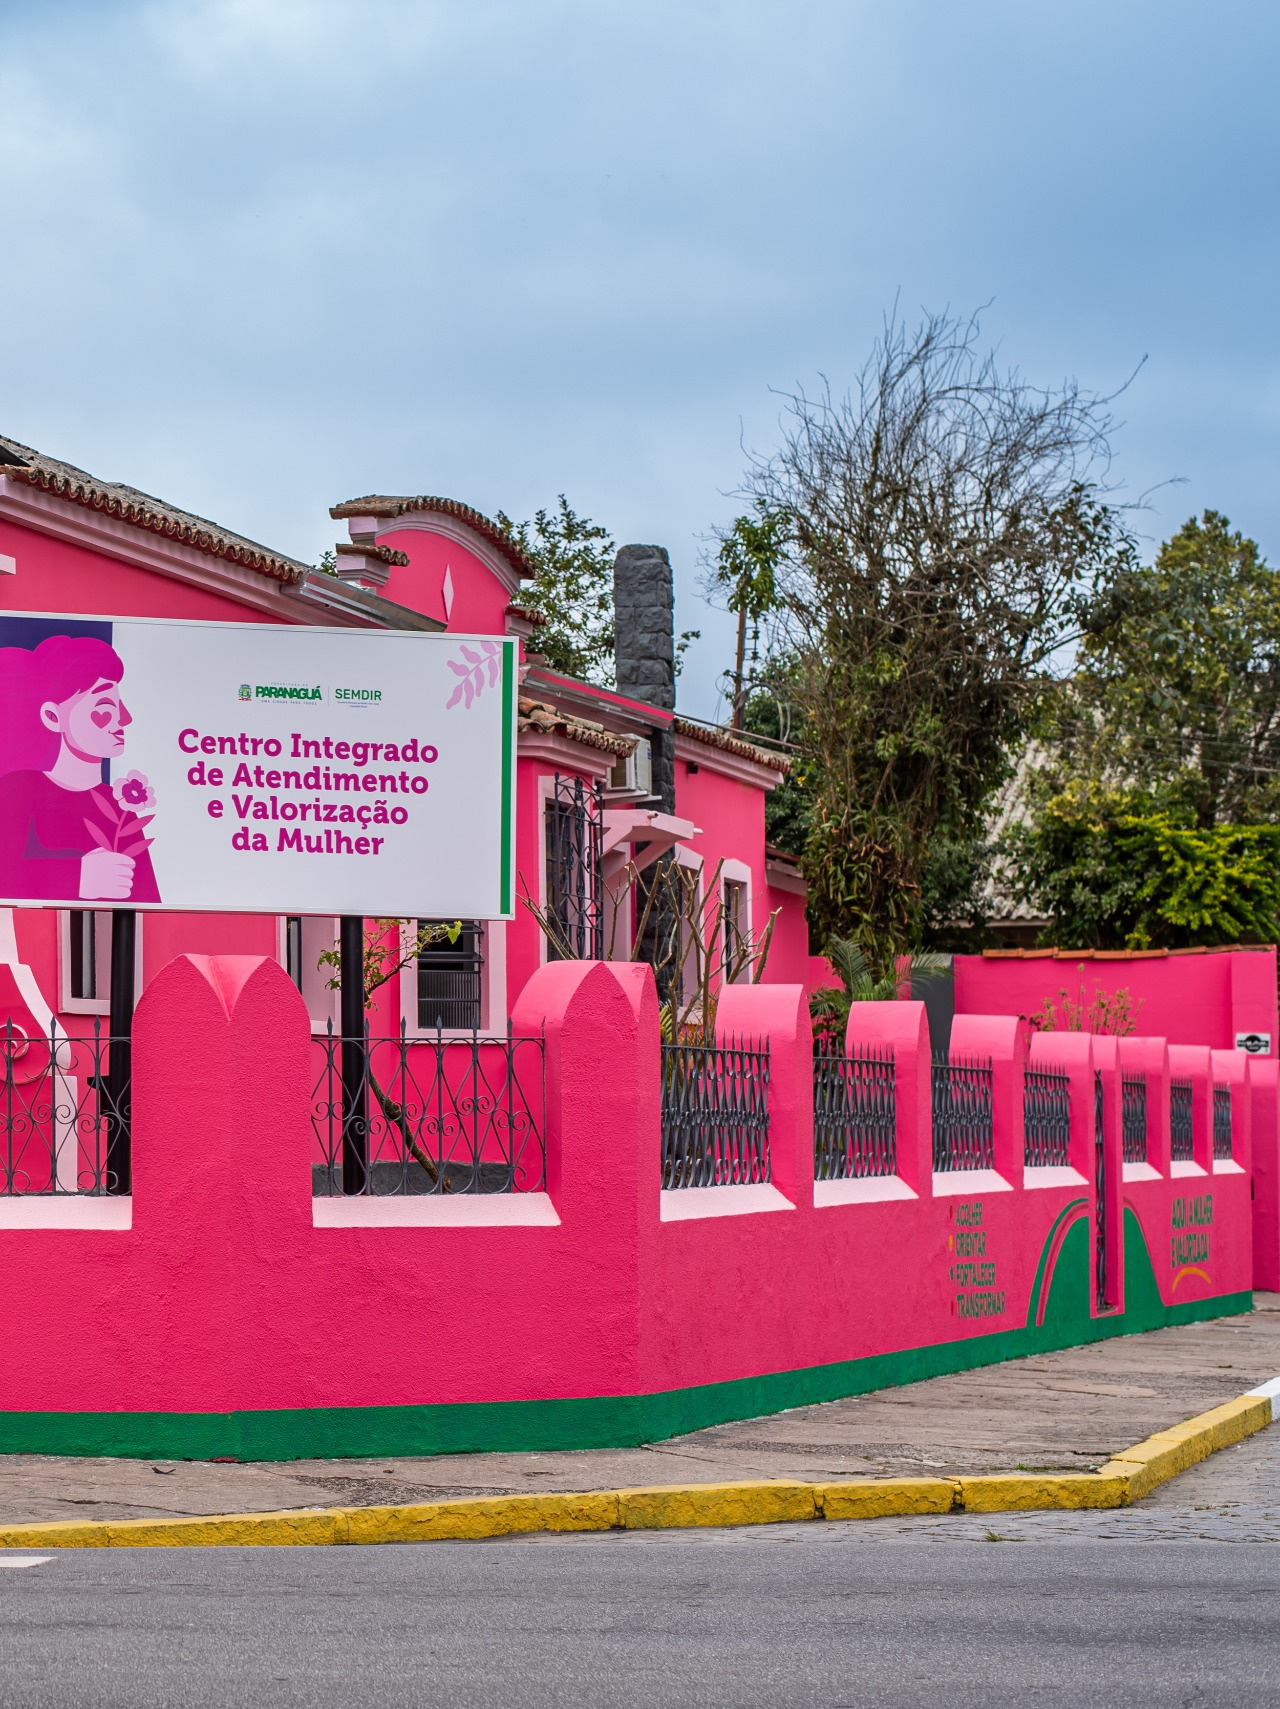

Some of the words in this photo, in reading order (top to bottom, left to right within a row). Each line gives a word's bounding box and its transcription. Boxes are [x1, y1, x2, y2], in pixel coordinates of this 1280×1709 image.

[256, 686, 322, 700] PARANAGUÁ
[335, 688, 382, 701] SEMDIR
[178, 728, 282, 757] Centro
[290, 734, 438, 767] Integrado
[188, 761, 224, 786] de
[232, 763, 429, 794] Atendimento
[208, 798, 224, 818] e
[232, 794, 409, 830] Valorização
[232, 826, 268, 851] da
[277, 828, 384, 855] Mulher
[956, 1202, 982, 1228] ACOLHER
[1193, 1194, 1213, 1226] MULHER
[956, 1231, 986, 1256] ORIENTAR
[956, 1262, 996, 1288] FORTALECER
[956, 1290, 1005, 1318] TRANSFORMAR
